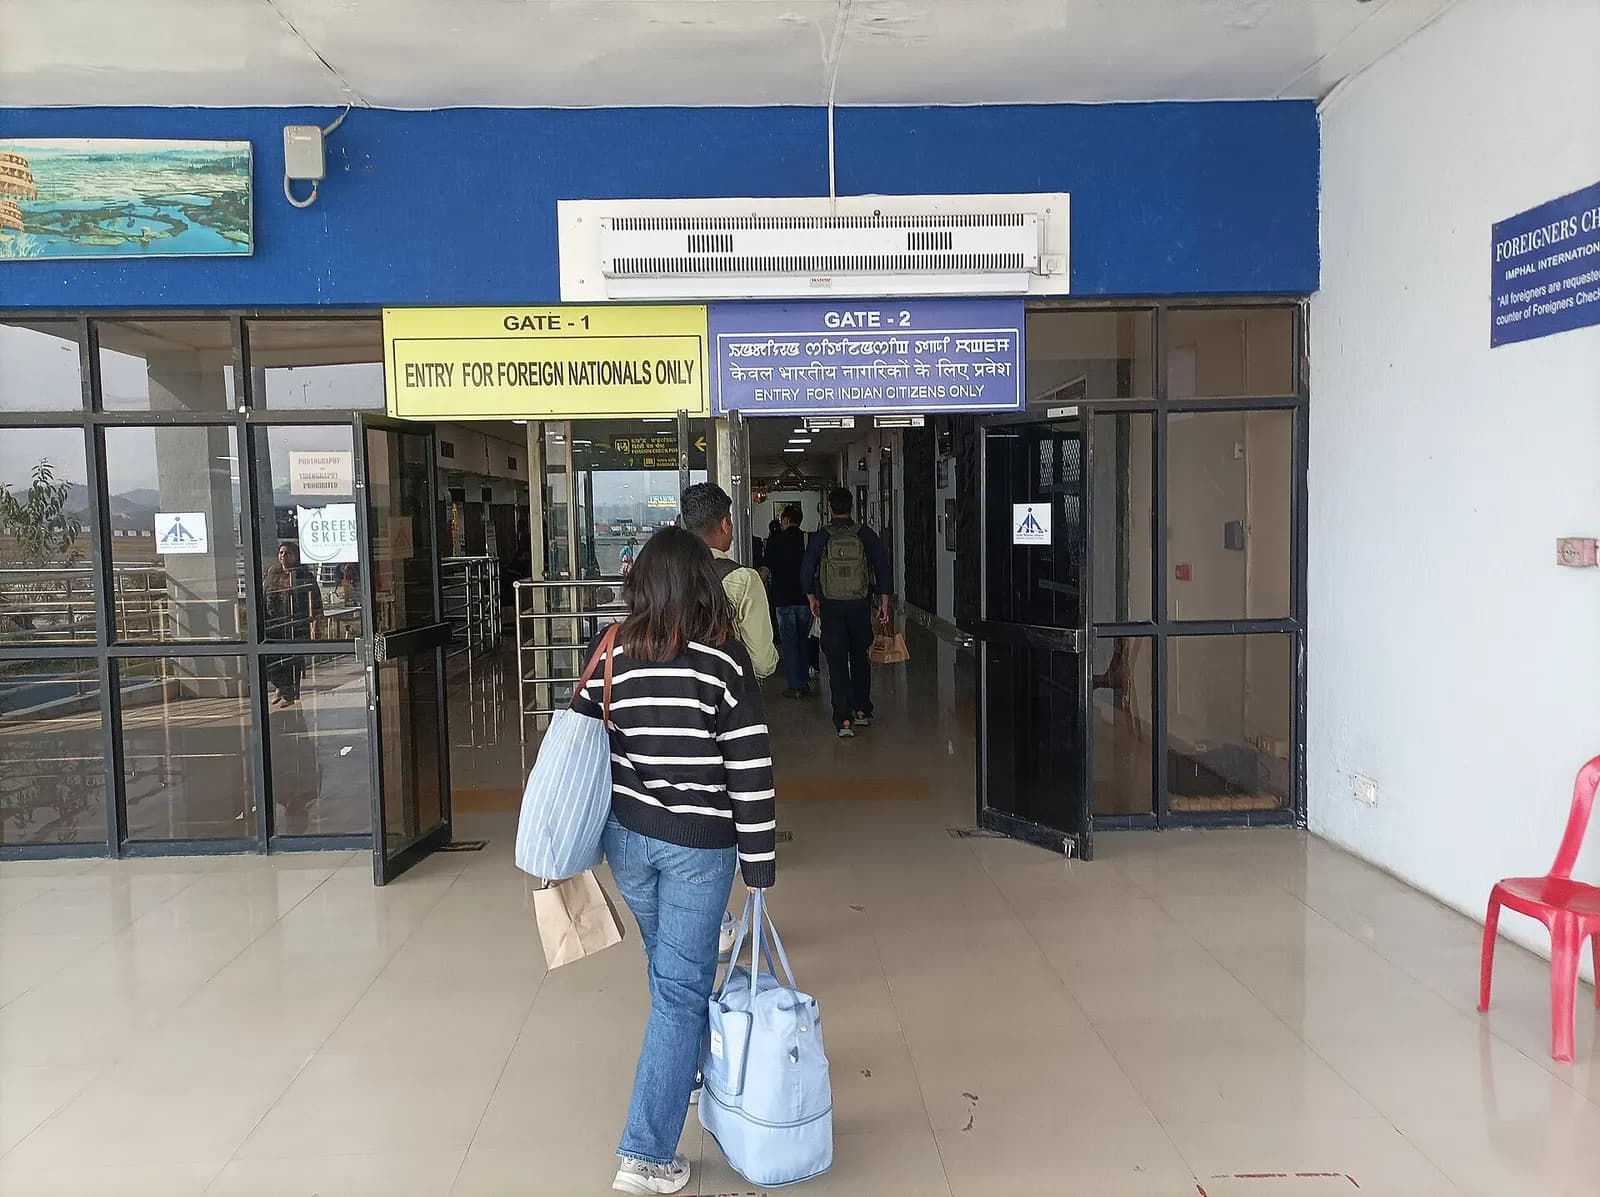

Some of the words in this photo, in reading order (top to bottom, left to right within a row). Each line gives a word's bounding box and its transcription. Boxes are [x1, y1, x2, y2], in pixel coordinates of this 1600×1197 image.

[1496, 215, 1578, 262] FOREIGNERS
[1505, 263, 1536, 281] IMPHAL
[1538, 241, 1600, 271] INTERNATION
[1510, 284, 1547, 305] foreigners
[1548, 281, 1561, 294] are
[1563, 270, 1600, 289] requeste
[503, 315, 561, 331] GATE
[581, 315, 591, 330] 1
[824, 311, 881, 328] GATE
[899, 310, 911, 327] 2
[1496, 311, 1522, 326] counter
[1523, 307, 1532, 319] of
[1533, 296, 1574, 317] Foreigners
[405, 362, 454, 388] ENTRY
[463, 362, 494, 387] FOR
[498, 361, 564, 387] FOREIGN
[568, 360, 651, 386] NATIONALS
[656, 359, 694, 385] ONLY
[729, 362, 774, 381] केवल
[779, 360, 837, 381] भारतीय
[841, 359, 910, 380] नागरिकों
[913, 358, 930, 378] के
[935, 358, 969, 380] लिए
[972, 357, 1011, 377] प्रवेश
[755, 388, 799, 401] ENTRY
[807, 388, 835, 400] FOR
[838, 387, 882, 400] INDIAN
[886, 385, 946, 399] CITIZENS
[949, 384, 985, 397] ONLY
[311, 519, 356, 532] GREEN
[311, 531, 357, 543] SKIES
